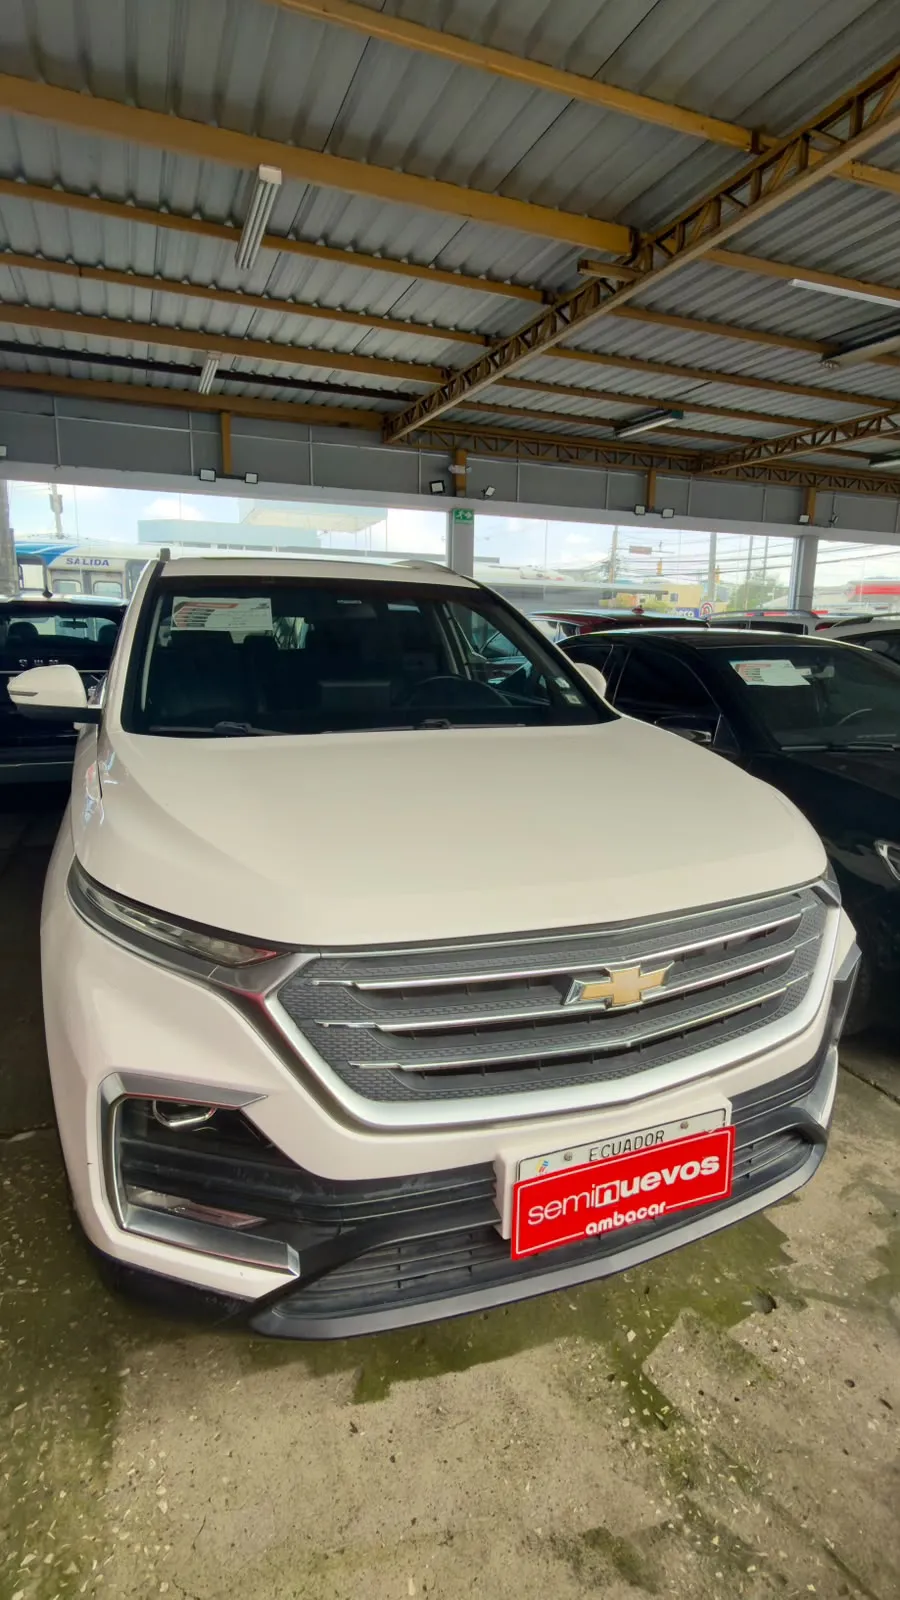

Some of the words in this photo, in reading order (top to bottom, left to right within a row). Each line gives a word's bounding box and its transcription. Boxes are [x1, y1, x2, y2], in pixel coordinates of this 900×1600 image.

[66, 557, 110, 566] SALIDA
[589, 1129, 665, 1162] ECUADOR
[585, 1201, 667, 1236] ambacar
